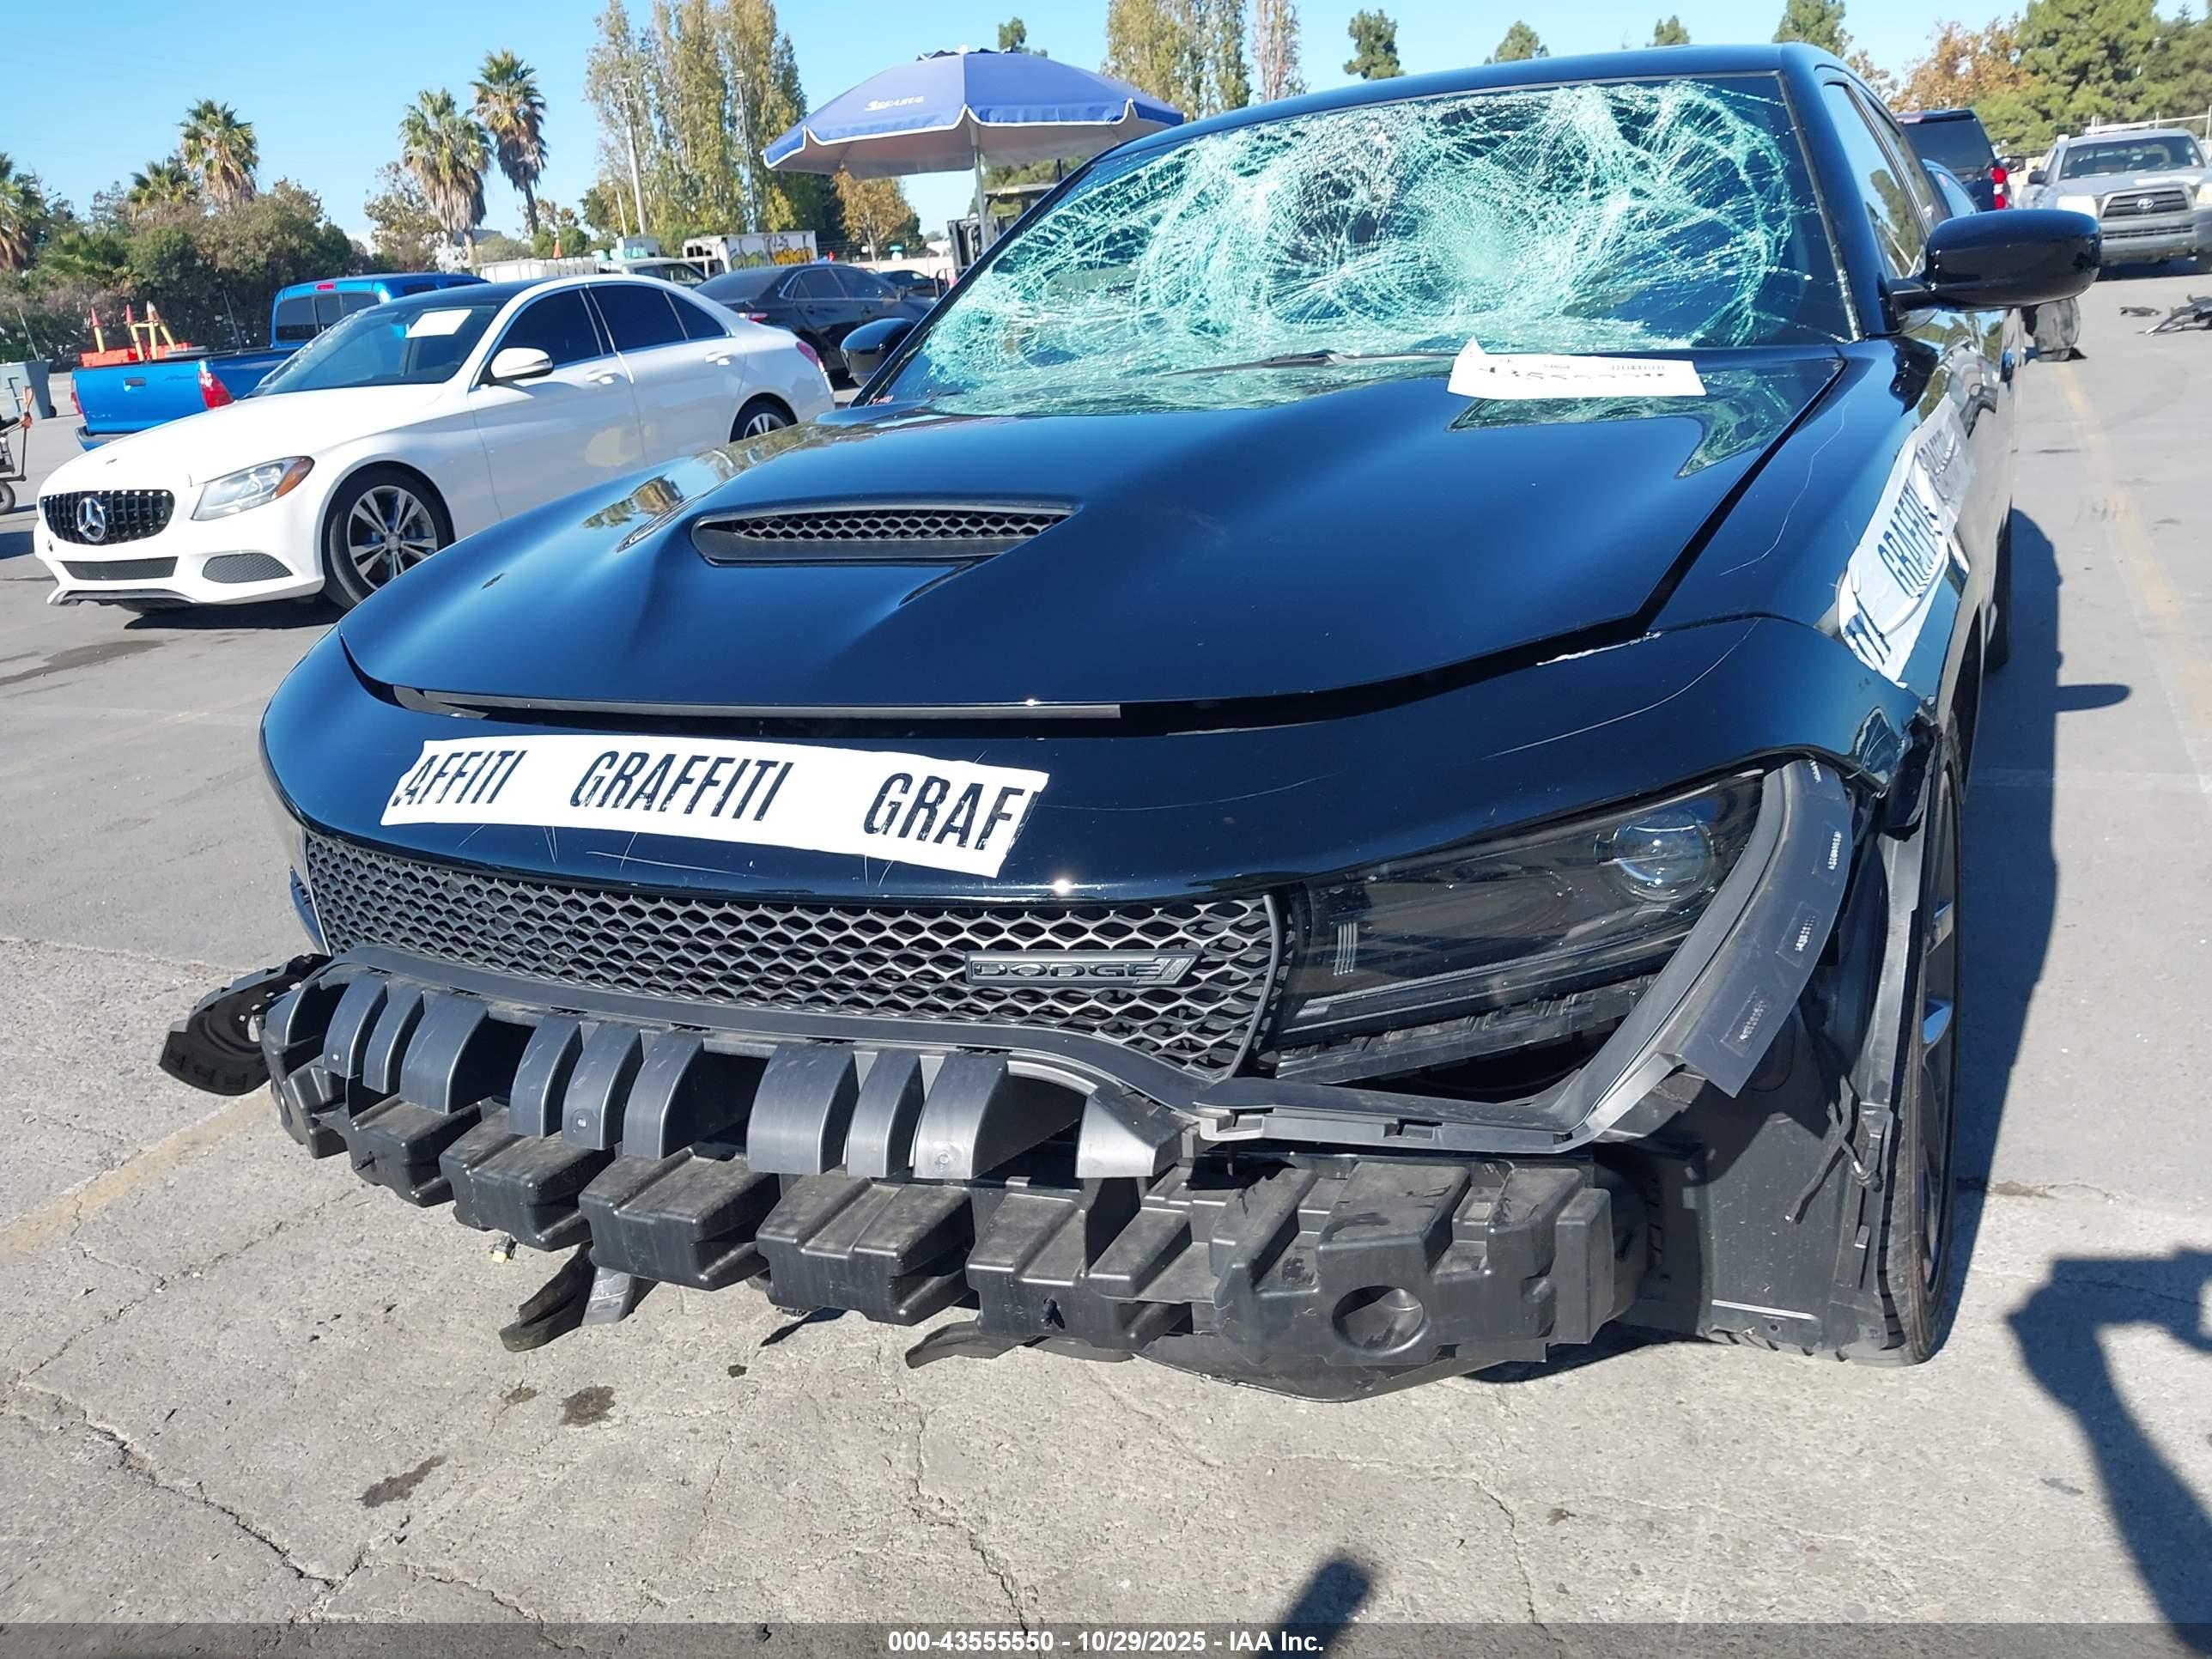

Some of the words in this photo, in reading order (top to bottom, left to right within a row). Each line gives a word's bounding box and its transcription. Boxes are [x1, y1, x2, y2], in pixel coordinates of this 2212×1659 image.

[392, 750, 528, 807] AFFITI
[569, 750, 794, 822] GRAFFITI
[974, 963, 1161, 978] DODGE
